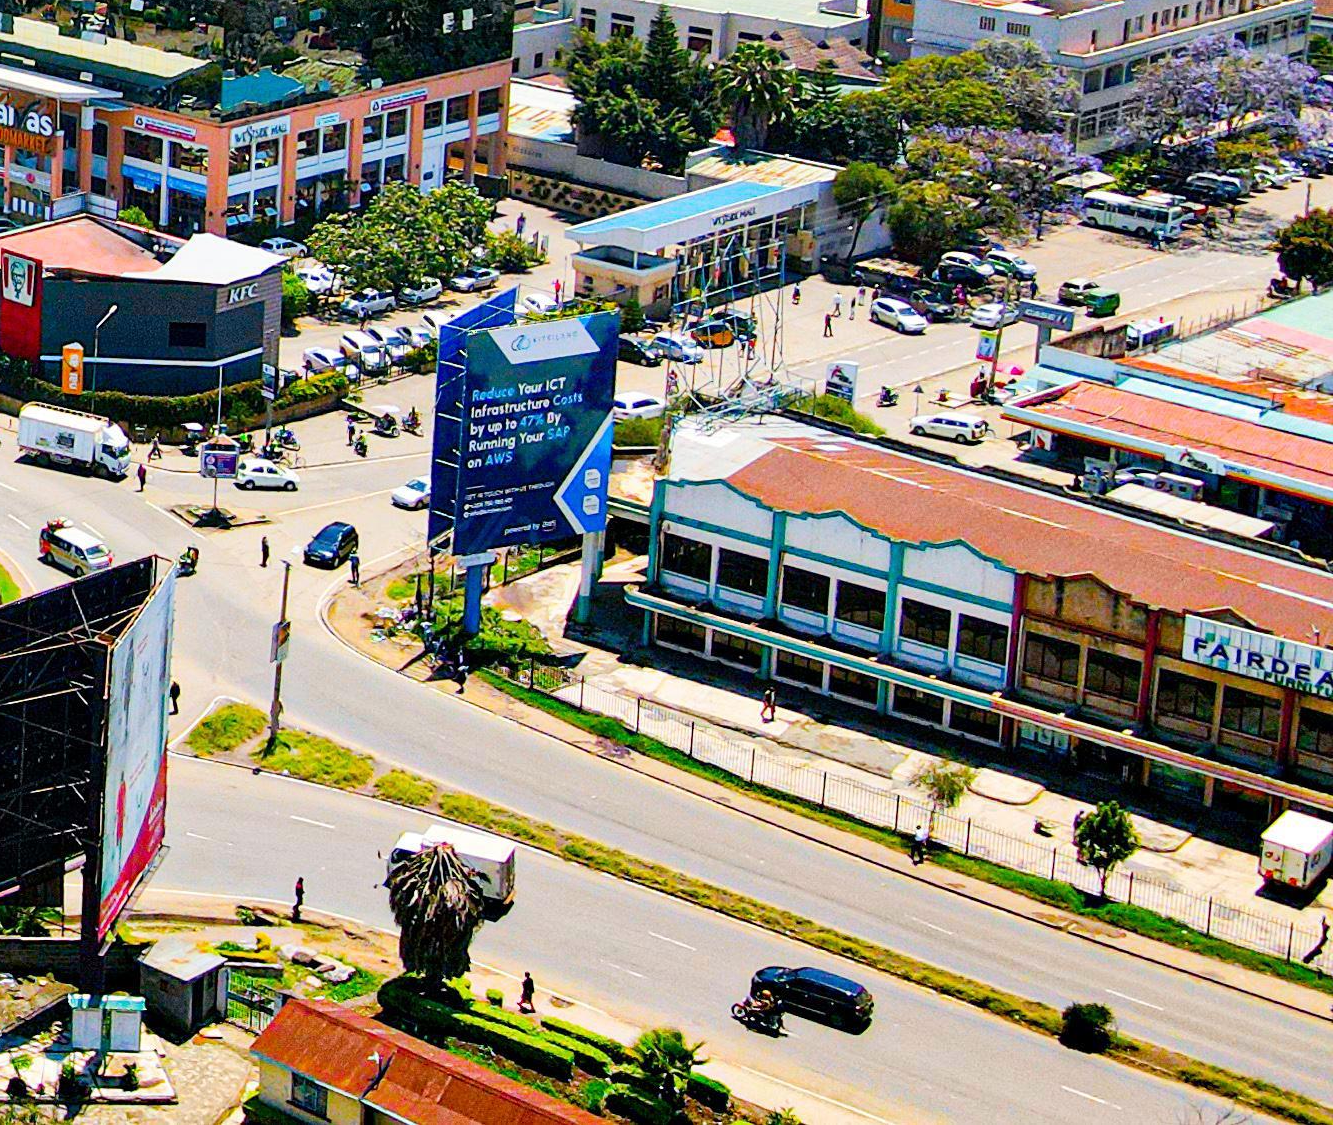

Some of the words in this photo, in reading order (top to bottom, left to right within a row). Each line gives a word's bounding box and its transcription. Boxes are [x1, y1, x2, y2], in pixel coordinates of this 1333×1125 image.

[228, 282, 259, 304] KFC
[472, 388, 515, 402] Reduce
[518, 382, 542, 396] Your
[546, 377, 567, 391] ICT
[471, 398, 550, 419] Infrastructure
[552, 392, 583, 406] Costs
[469, 423, 485, 438] by
[487, 424, 502, 435] up
[505, 419, 517, 430] to
[520, 414, 544, 427] 47%
[547, 412, 562, 427] By
[469, 436, 516, 452] Running
[519, 432, 545, 444] Your
[547, 426, 571, 440] SAP
[467, 457, 482, 469] on
[485, 451, 513, 466] AWS
